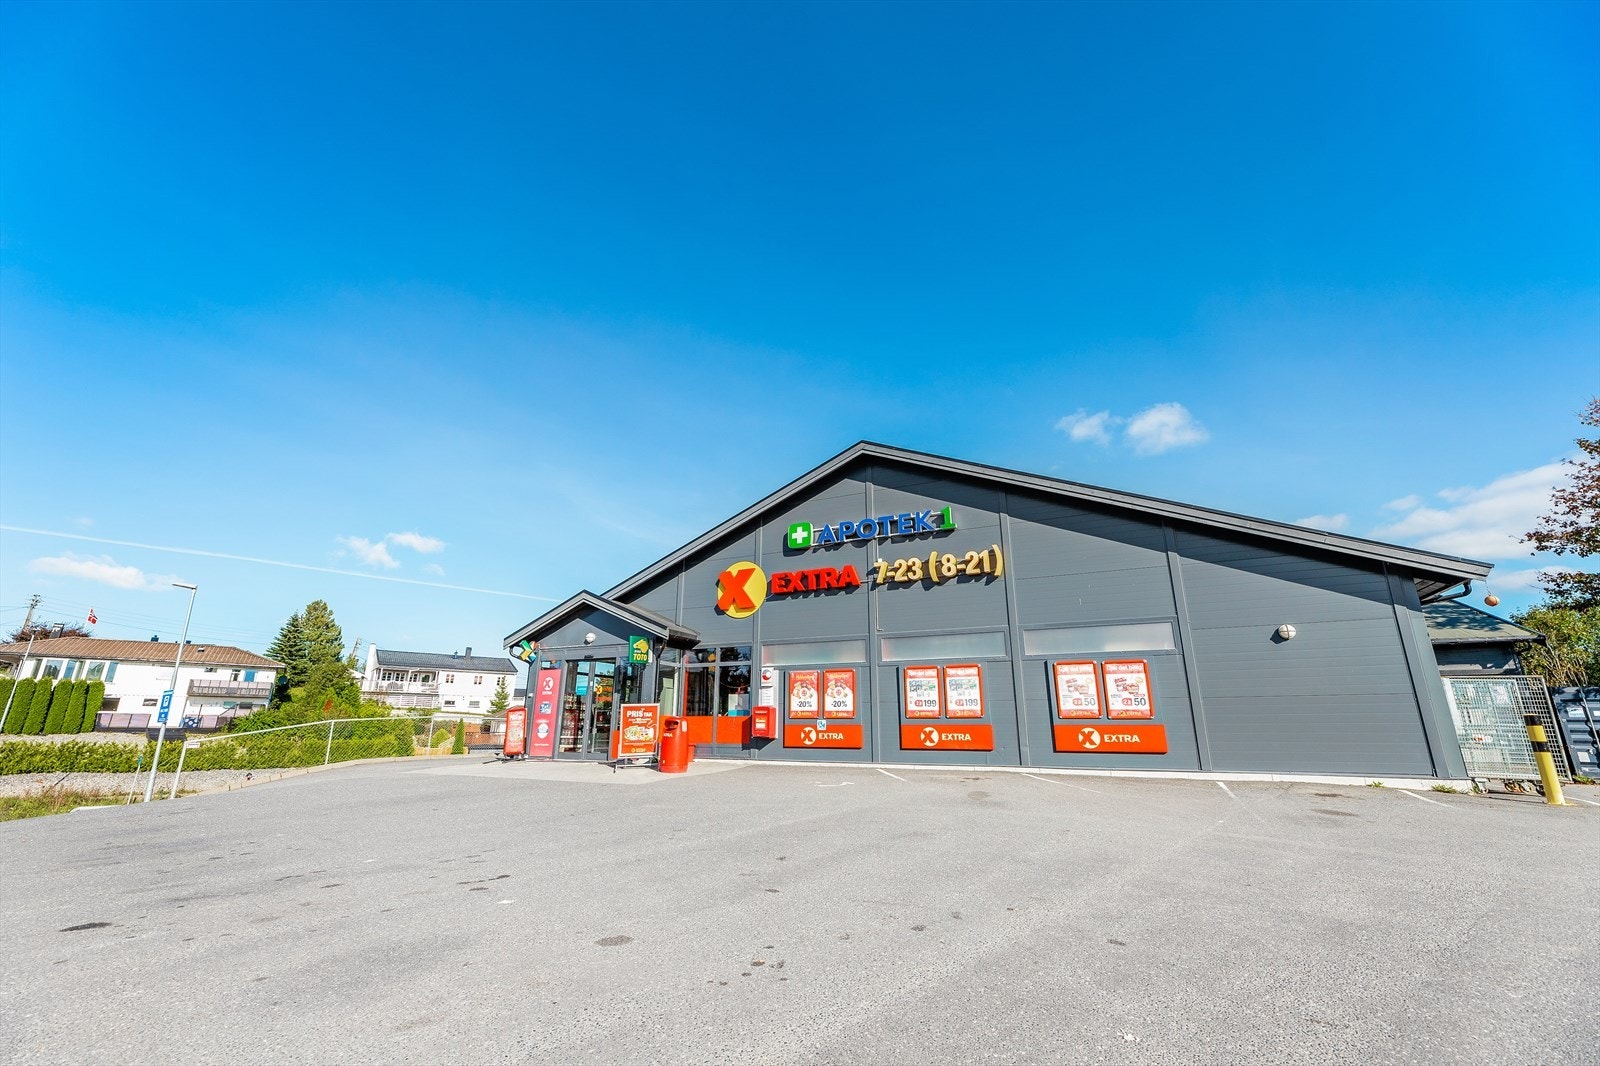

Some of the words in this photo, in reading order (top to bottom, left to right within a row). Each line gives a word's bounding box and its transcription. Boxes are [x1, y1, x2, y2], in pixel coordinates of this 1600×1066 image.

[818, 509, 934, 544] APOTEK
[938, 506, 958, 530] 1
[873, 558, 924, 584] 7-23
[928, 544, 1004, 583] (8-21)
[771, 565, 862, 594] EXTRA
[633, 653, 648, 661] TOTO
[796, 700, 813, 708] -20%
[831, 700, 848, 708] -20%
[923, 699, 937, 708] 199
[964, 698, 979, 707] 199
[1083, 697, 1096, 706] 50
[1133, 697, 1147, 706] 50
[627, 710, 643, 718] PRIS
[818, 732, 844, 740] EXTRA
[941, 733, 972, 741] EXTRA
[1103, 734, 1141, 742] EXTRA
